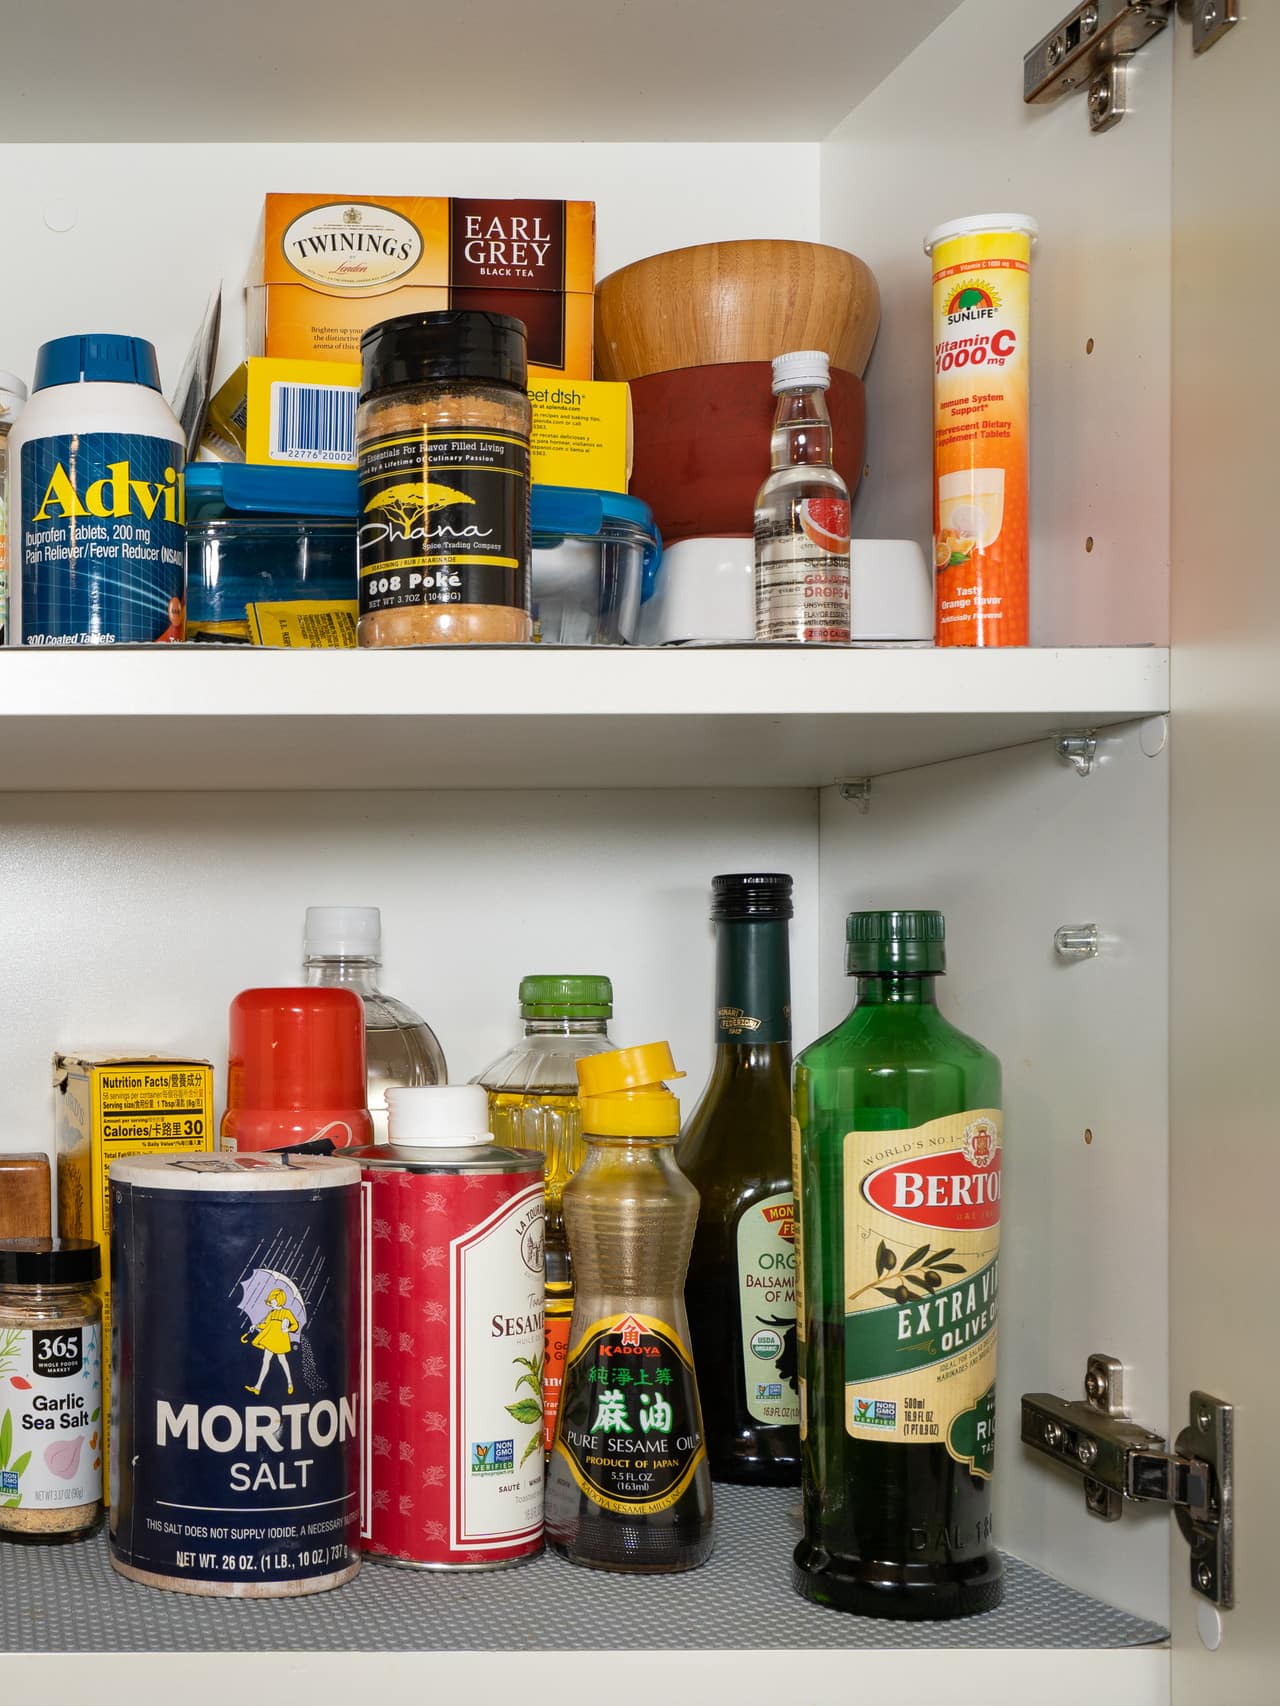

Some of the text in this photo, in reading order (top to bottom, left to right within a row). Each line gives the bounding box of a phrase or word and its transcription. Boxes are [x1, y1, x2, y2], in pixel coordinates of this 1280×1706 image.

[465, 216, 551, 241] EARL
[293, 233, 412, 261] TWININGS
[465, 241, 551, 266] GREY
[329, 261, 368, 274] London
[480, 268, 534, 278] BLACK TEA
[948, 308, 993, 325] SUNLIFE
[936, 329, 1016, 357] Vitamin C
[936, 346, 1005, 374] 1000 mg
[940, 393, 1004, 410] Immune System
[982, 420, 1012, 430] Dietary
[980, 430, 1010, 439] Tablets
[288, 449, 318, 459] 22776
[322, 451, 352, 461] 20002
[367, 448, 401, 464] Essentials
[403, 445, 417, 455] For
[451, 442, 477, 451] Filled
[480, 442, 505, 454] Living
[384, 454, 494, 469] Lifetime Culinary Passion
[32, 461, 185, 526] Advil
[26, 525, 151, 547] Ibuprofen Tablets, 200 mg
[422, 541, 502, 551] Spice Trading Company
[26, 549, 42, 565] Pain
[122, 544, 160, 561] Reducer
[369, 571, 462, 596] 808 Poké
[804, 587, 843, 598] DROPS
[957, 587, 982, 597] Tasty
[942, 597, 971, 609] Orange
[27, 633, 78, 645] 300 Coated
[102, 1076, 142, 1089] Nutrition
[184, 1119, 203, 1135] 30
[863, 1140, 924, 1167] WORLD'S
[892, 1171, 1000, 1208] BERTO
[515, 1220, 527, 1236] LA
[746, 1274, 795, 1288] BALSAMI
[765, 1290, 781, 1303] OF
[898, 1283, 977, 1340] EXTRA
[941, 1310, 987, 1351] OLIVE
[37, 1336, 79, 1360] 365
[758, 1336, 775, 1344] USDA
[599, 1345, 661, 1357] KADOYA
[32, 1393, 85, 1412] Garlic
[904, 1397, 925, 1409] 500ml
[21, 1411, 89, 1430] Sea Salt
[156, 1393, 357, 1452] MORTON
[855, 1417, 895, 1425] VERIFIED
[904, 1411, 933, 1422] 16.9 OZ
[567, 1431, 695, 1454] PURE SESAME OIL
[473, 1462, 513, 1471] VERIFIED
[586, 1455, 679, 1470] PRODUCT OF JAPAN
[229, 1459, 314, 1491] SALT
[617, 1481, 650, 1492] (163ml)
[613, 1503, 646, 1514] SESAME
[146, 1518, 344, 1540] THIS SALT DOES NOT SUPPLY NECESSARY
[176, 1544, 343, 1573] NET WT. 26 OZ. (1 LB., 10 OZ.) 737
